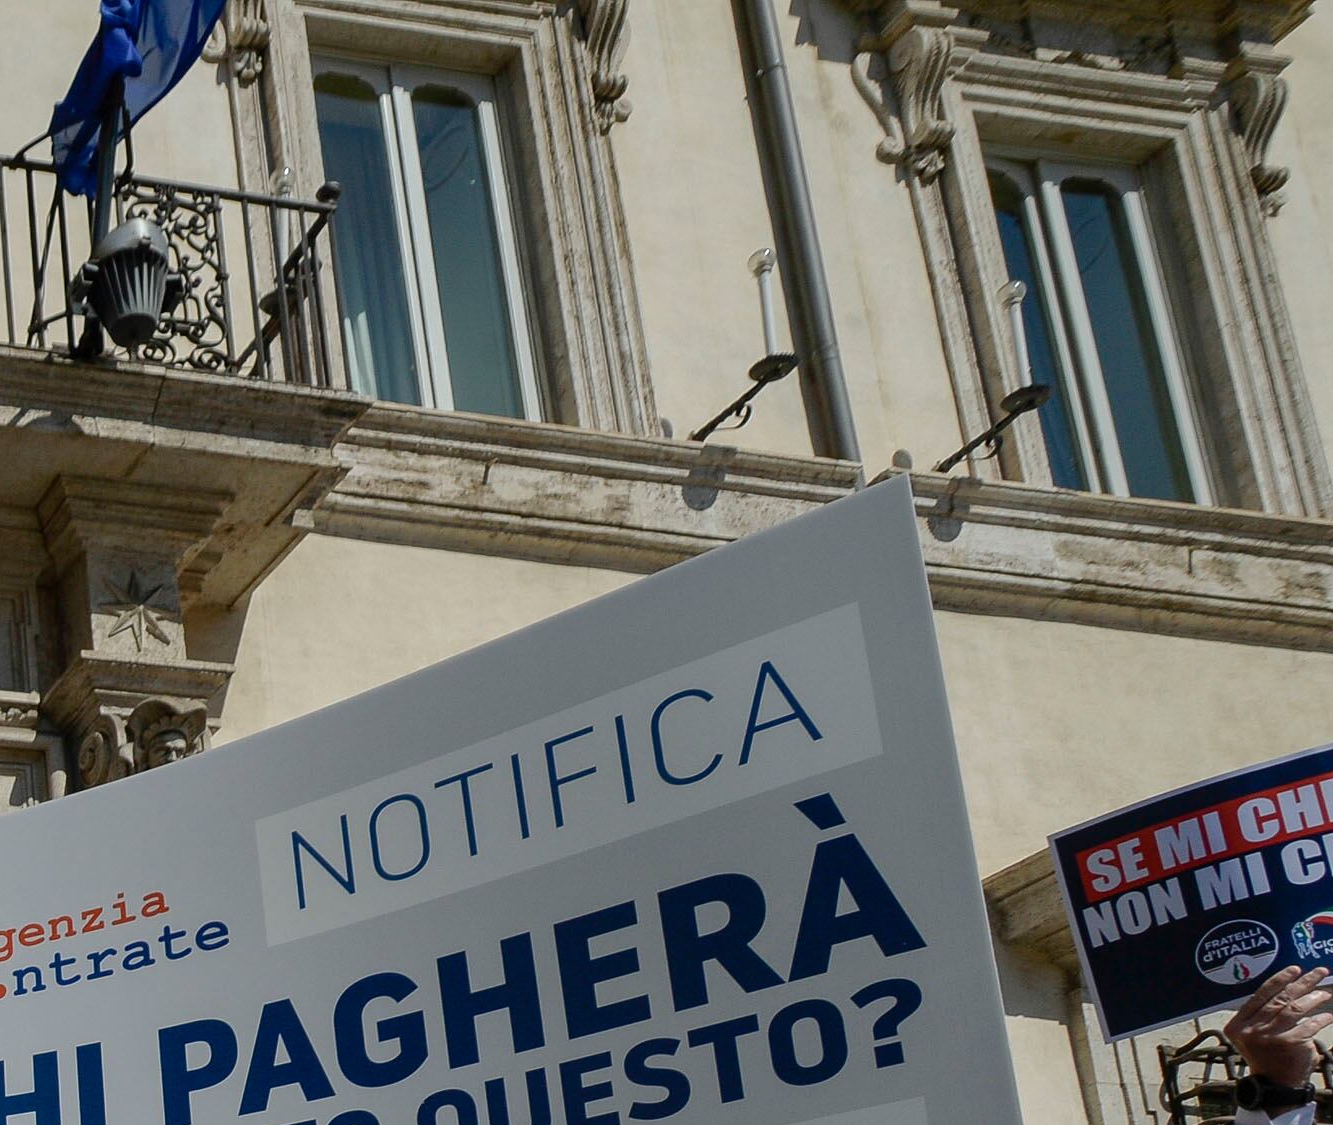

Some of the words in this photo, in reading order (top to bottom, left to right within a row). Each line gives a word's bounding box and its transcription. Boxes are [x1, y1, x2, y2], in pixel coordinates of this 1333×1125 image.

[290, 660, 823, 911] NOTIFICA
[1086, 838, 1149, 893] SE
[1154, 812, 1228, 871] MI
[1237, 779, 1333, 843] CHI
[1083, 876, 1188, 949] NON
[1194, 852, 1272, 910] MI
[1203, 936, 1270, 962] d'ITALIA
[1204, 927, 1262, 950] FRATELLI
